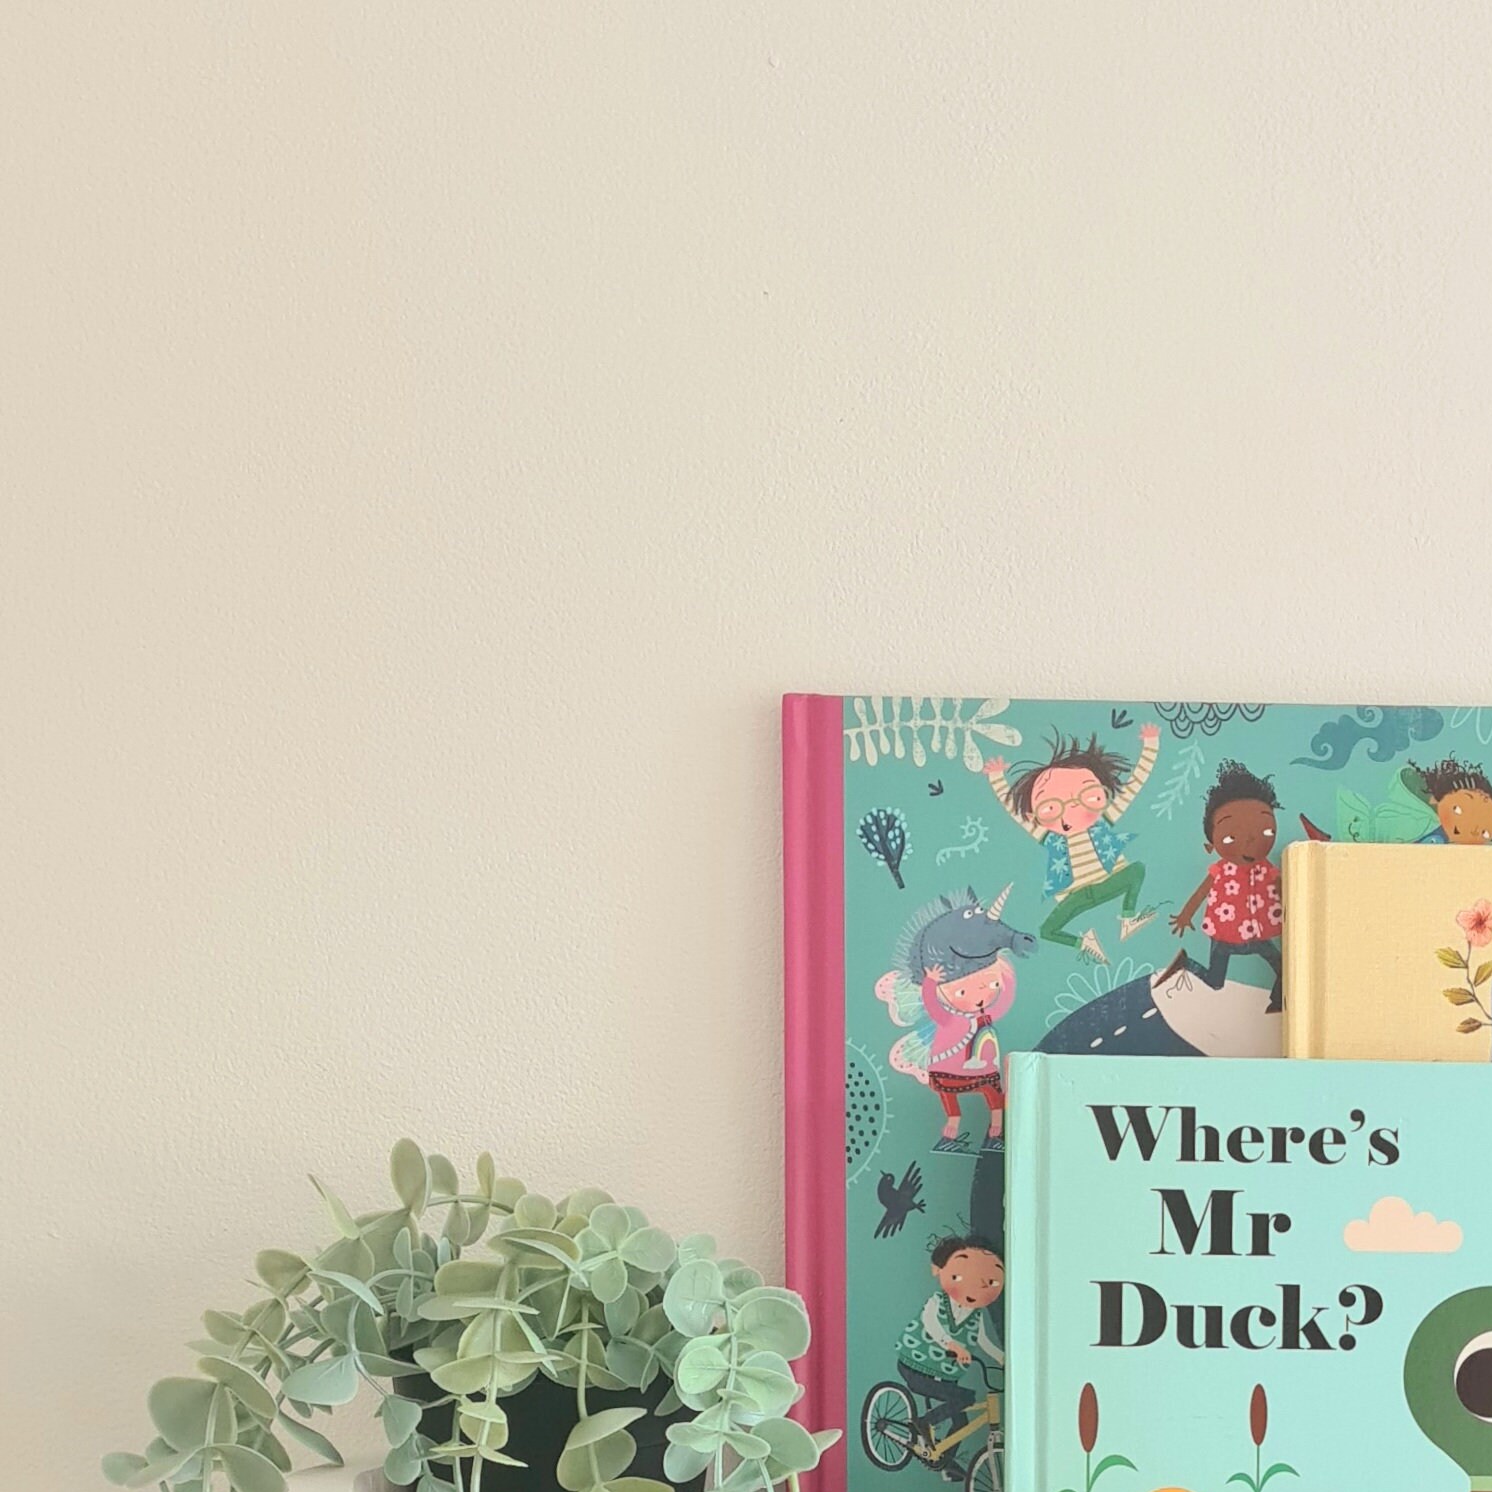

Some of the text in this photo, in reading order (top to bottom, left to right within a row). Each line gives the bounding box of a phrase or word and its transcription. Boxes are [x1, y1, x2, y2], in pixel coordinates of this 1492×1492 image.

[1085, 1104, 1401, 1167] Where’s
[1148, 1188, 1292, 1257] Mr
[1089, 1280, 1384, 1351] Duck?
